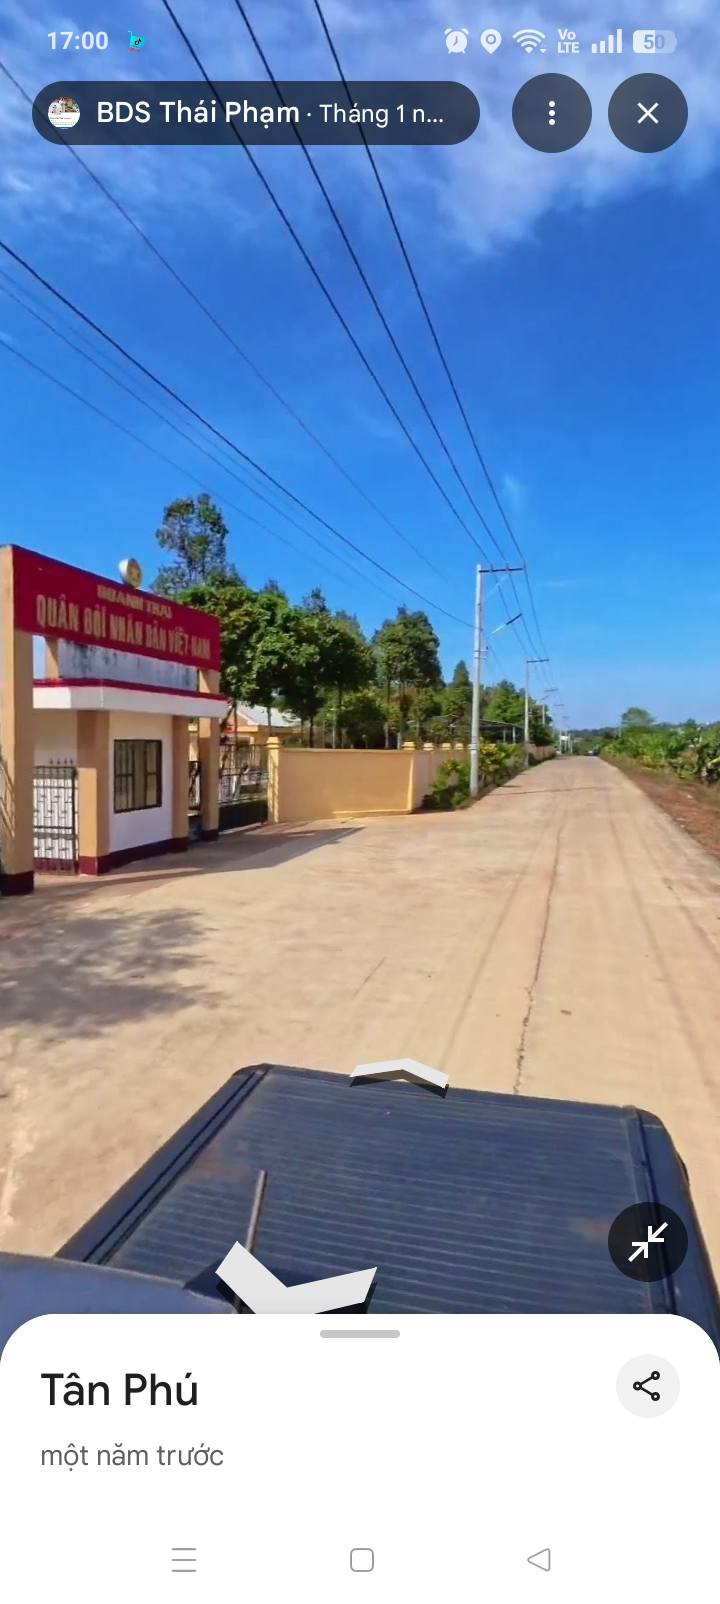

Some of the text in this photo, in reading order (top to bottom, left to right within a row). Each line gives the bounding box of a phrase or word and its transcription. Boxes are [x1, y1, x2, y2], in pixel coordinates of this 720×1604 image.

[36, 593, 79, 632] QUÂN
[84, 604, 107, 638] ĐỘI
[109, 614, 143, 646] NHÂN
[145, 620, 167, 652] DÂN
